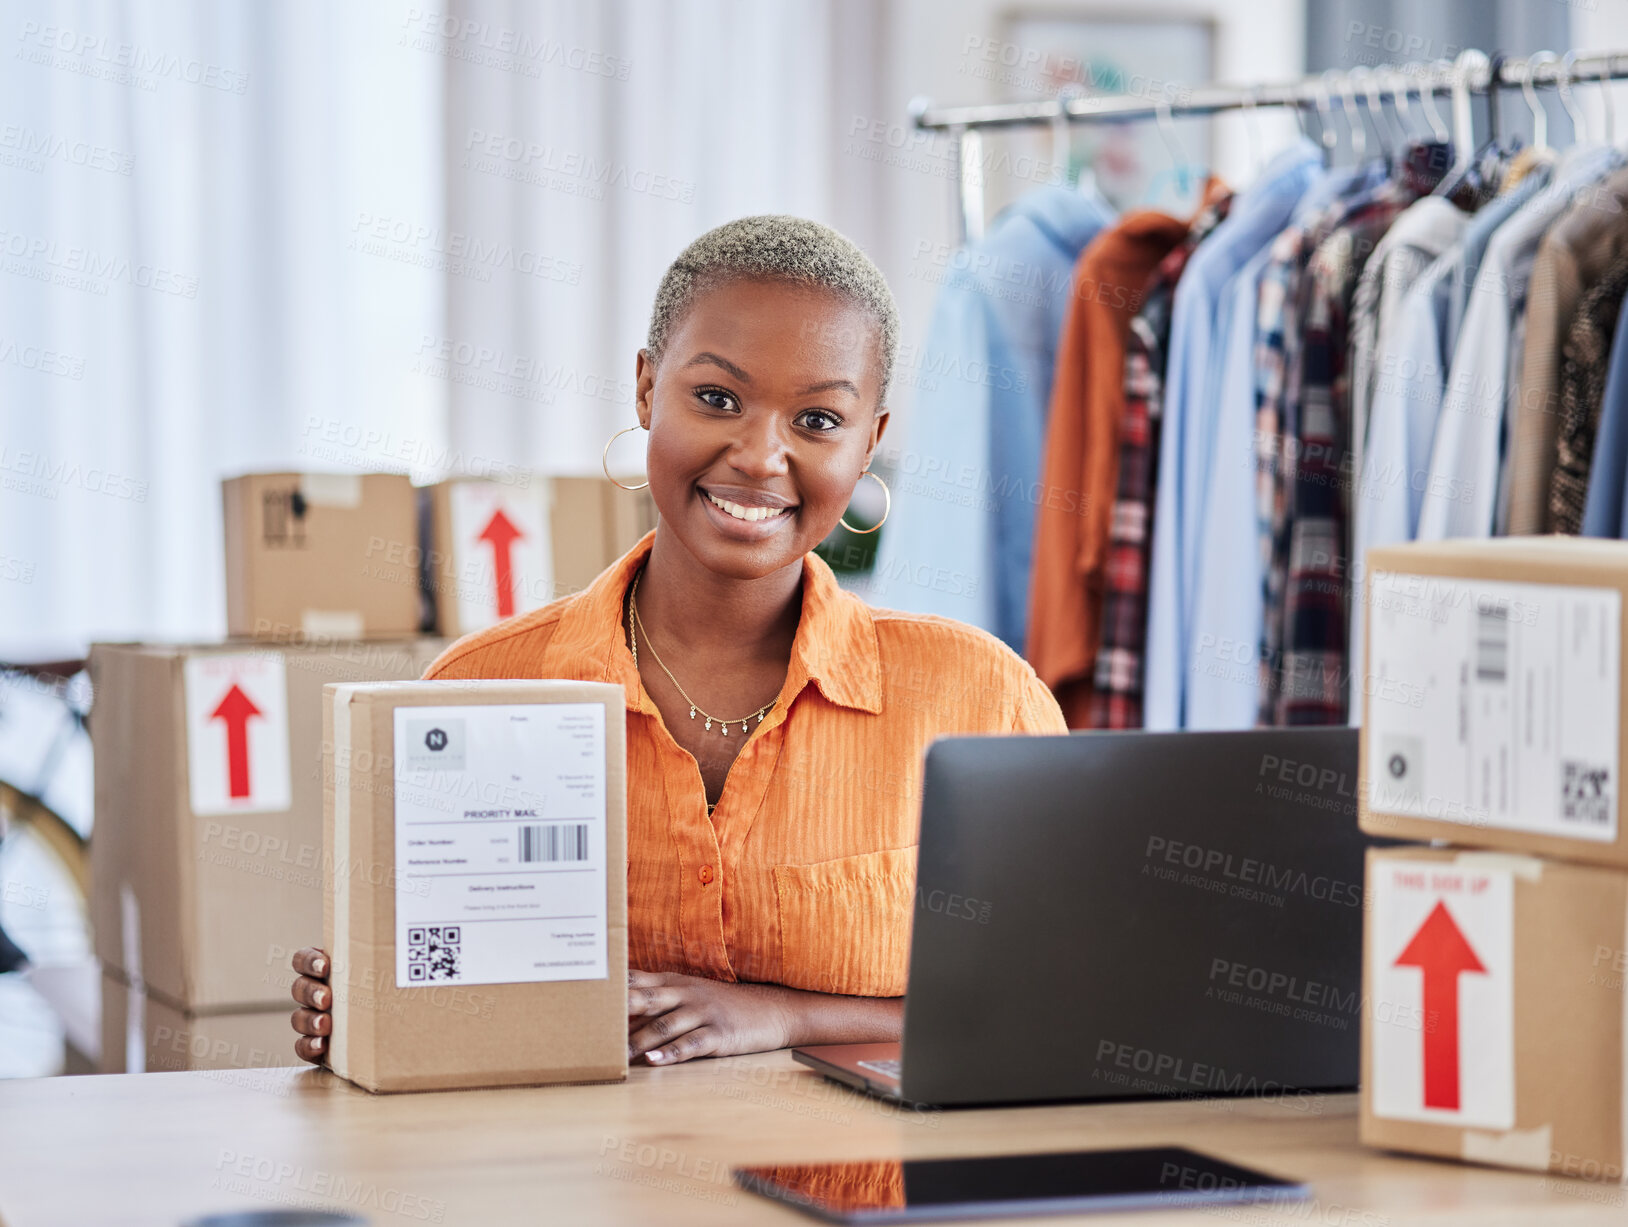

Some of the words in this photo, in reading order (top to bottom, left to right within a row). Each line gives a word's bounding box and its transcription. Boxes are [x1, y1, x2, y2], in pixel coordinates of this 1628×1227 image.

[430, 733, 443, 746] N
[464, 810, 511, 818] PRIORITY
[515, 809, 537, 817] MAIL
[468, 885, 495, 893] Delivery
